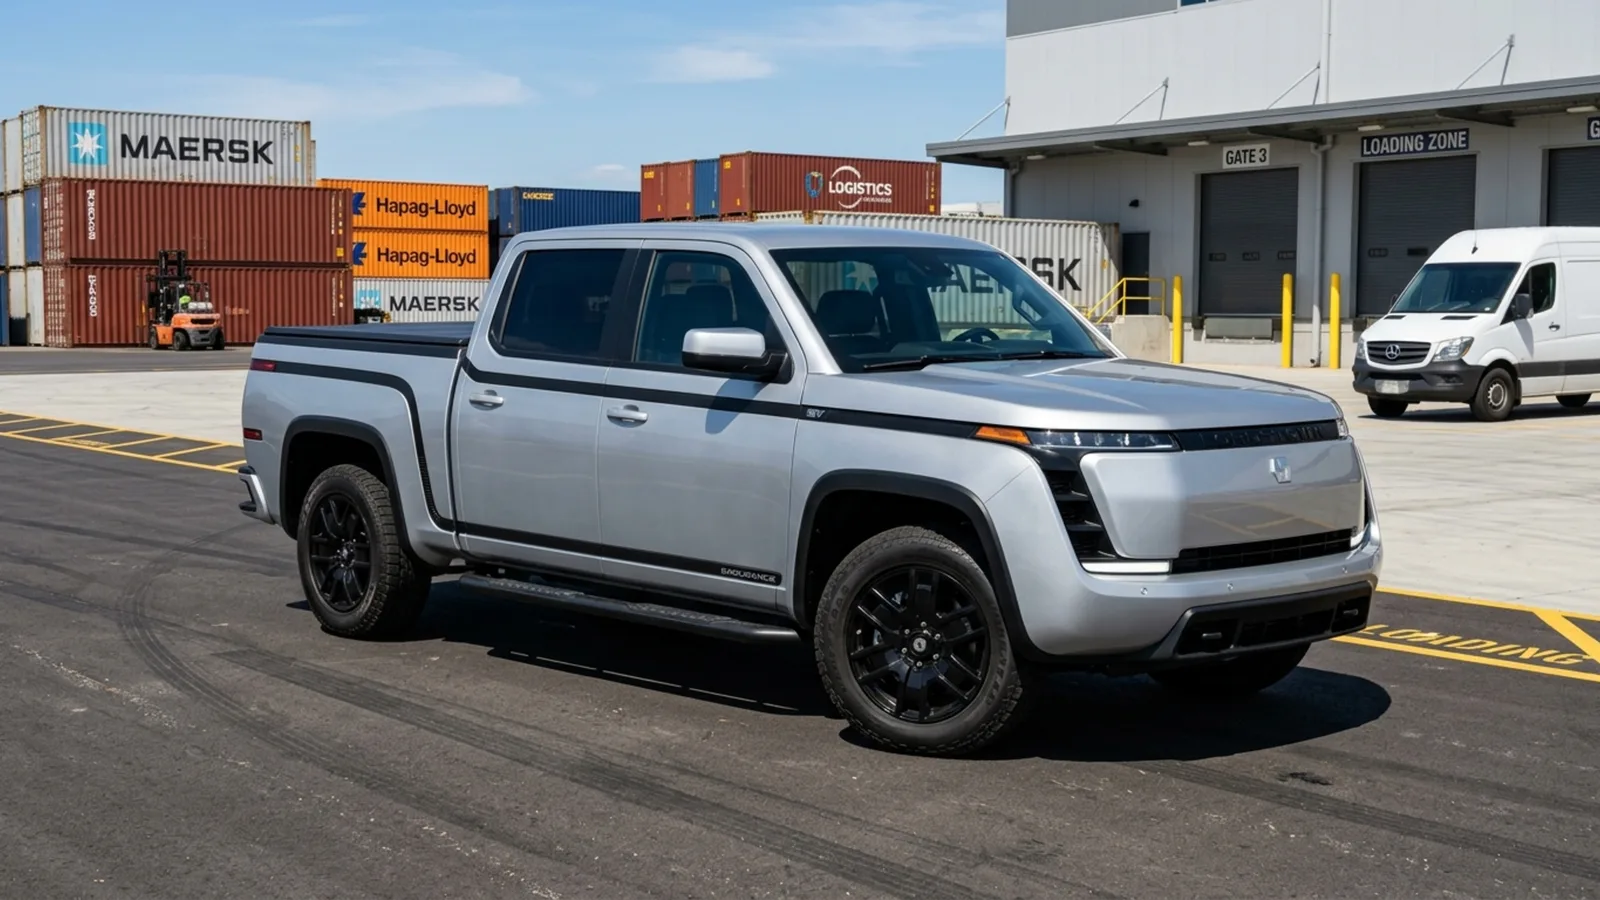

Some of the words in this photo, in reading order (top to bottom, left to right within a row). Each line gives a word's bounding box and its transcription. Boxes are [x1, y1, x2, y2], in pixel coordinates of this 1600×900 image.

[120, 133, 274, 165] MAERSK
[1363, 135, 1424, 155] LOADING
[1428, 131, 1467, 150] ZONE
[1226, 148, 1256, 165] GATE
[1259, 147, 1268, 163] 3
[828, 181, 893, 196] LOGISTICS
[376, 197, 476, 219] Hapag-Lloyd
[377, 247, 476, 267] Hapag-Lloyd
[389, 295, 480, 312] MAERSK
